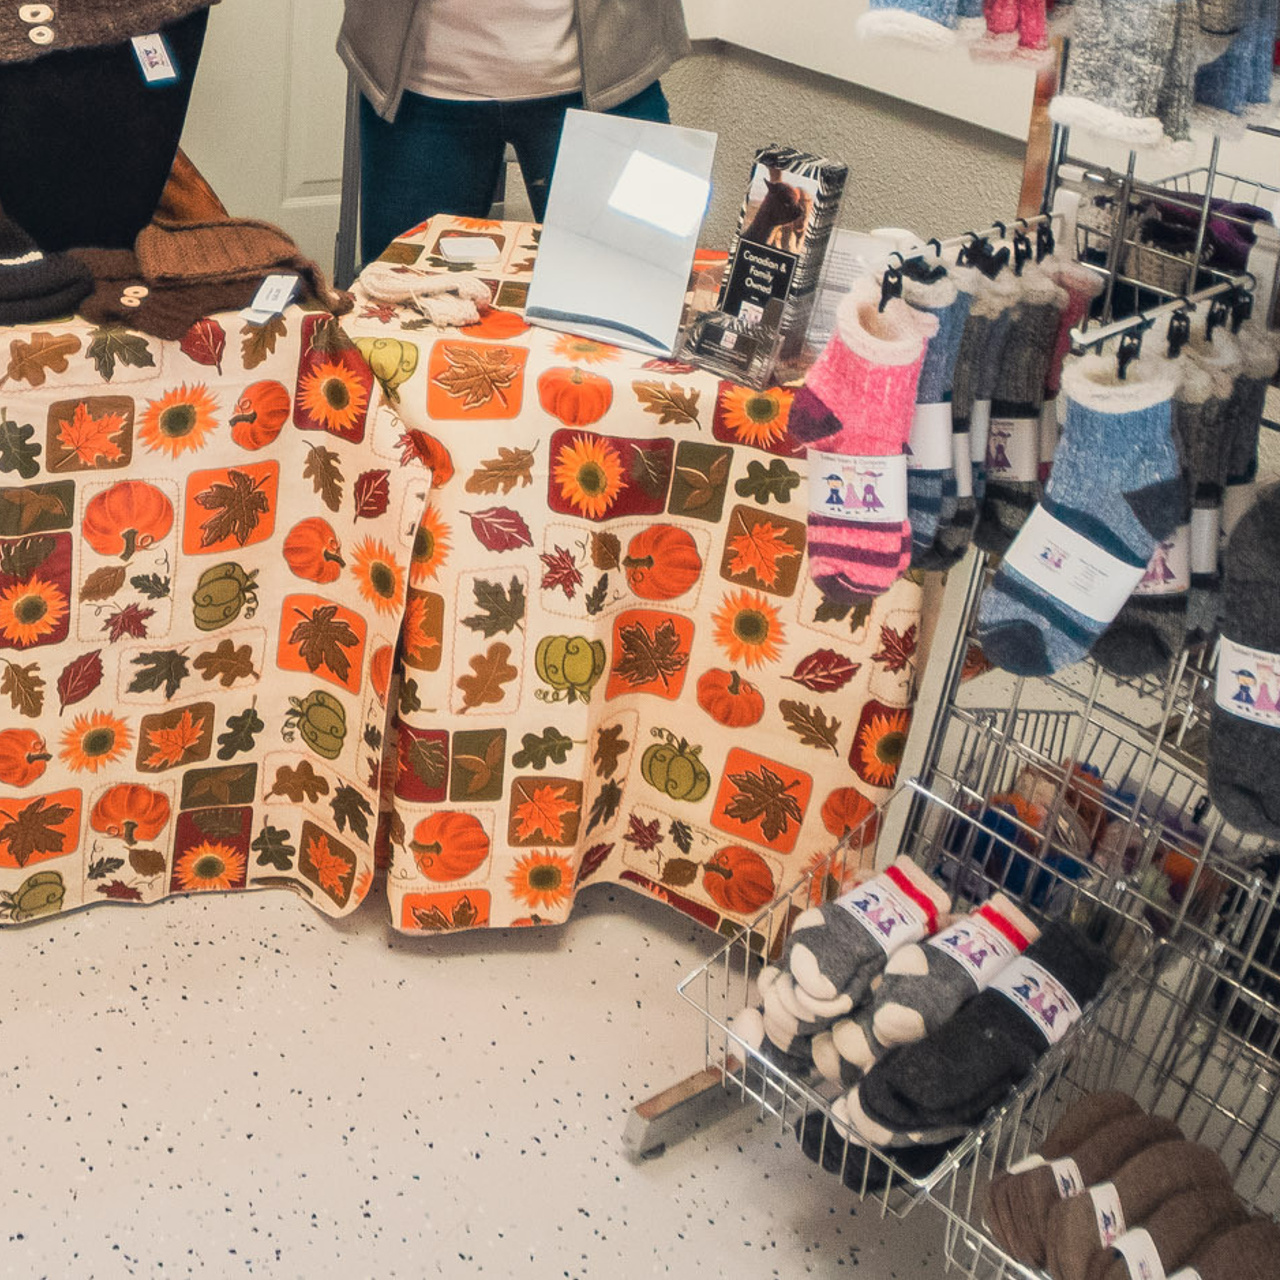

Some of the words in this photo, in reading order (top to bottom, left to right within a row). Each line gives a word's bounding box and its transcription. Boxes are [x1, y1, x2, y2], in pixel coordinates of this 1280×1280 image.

[743, 250, 779, 270] Canadian
[780, 262, 787, 273] &
[744, 277, 772, 294] Owned
